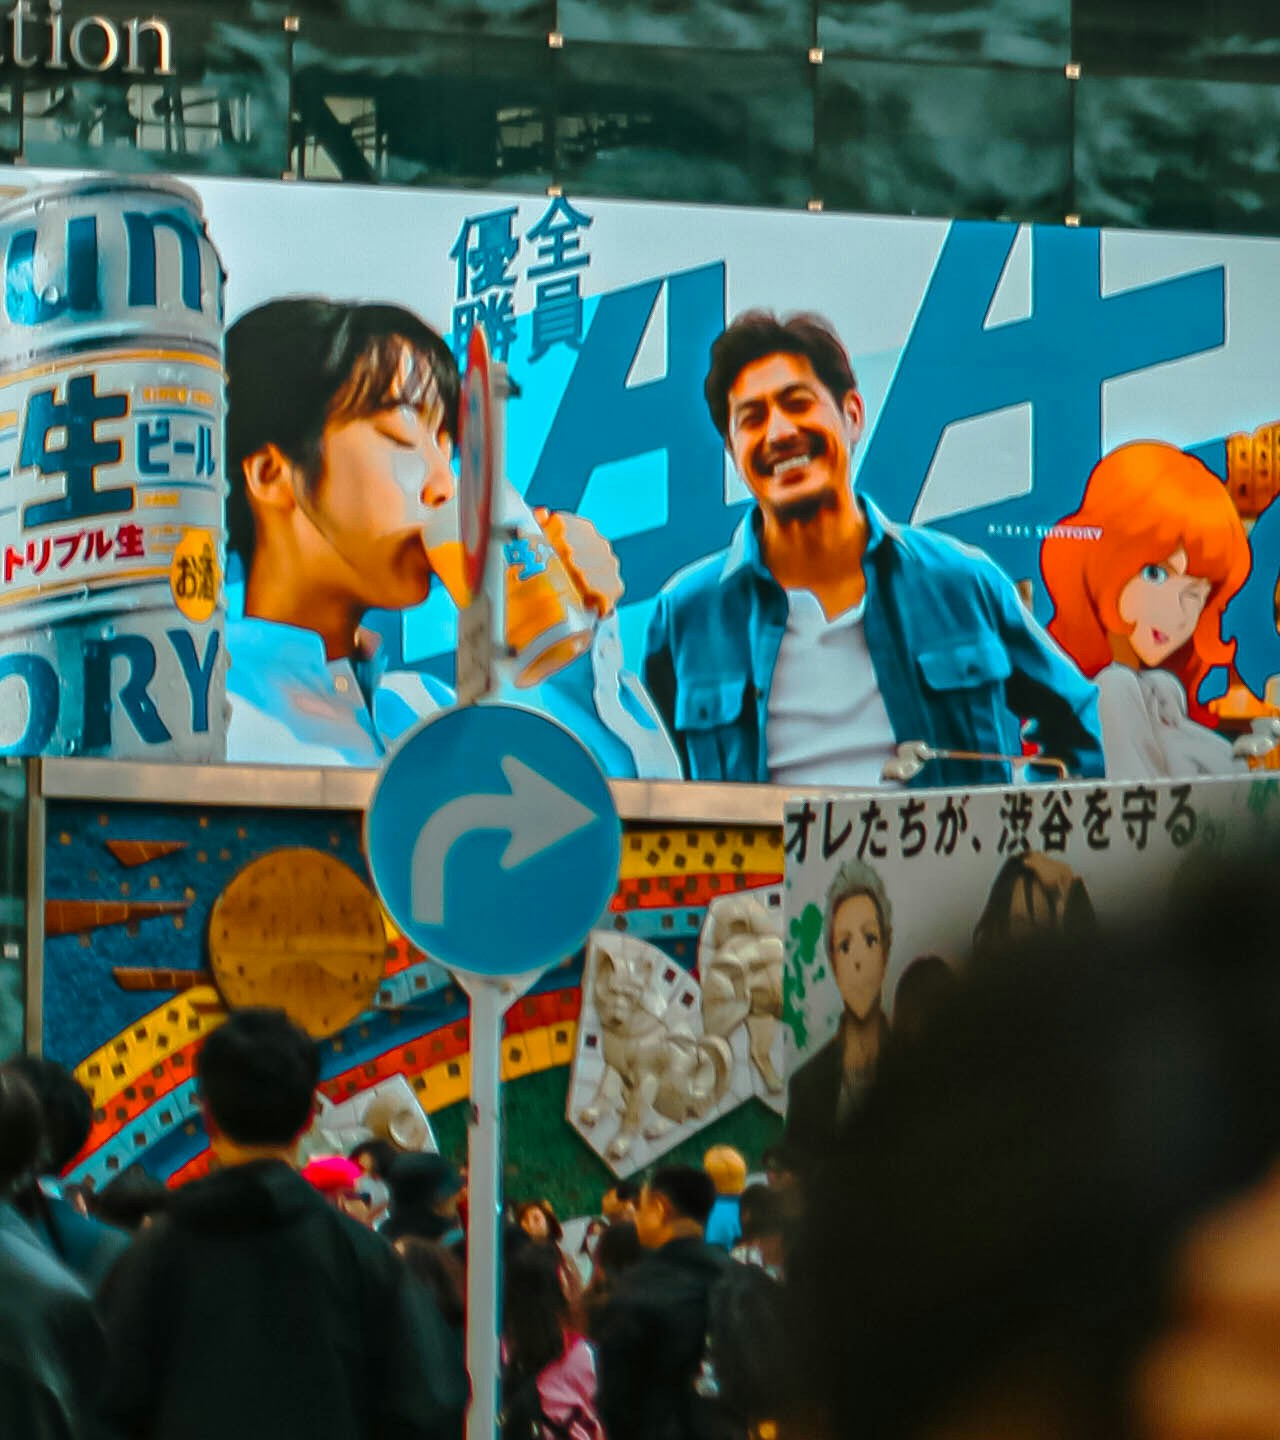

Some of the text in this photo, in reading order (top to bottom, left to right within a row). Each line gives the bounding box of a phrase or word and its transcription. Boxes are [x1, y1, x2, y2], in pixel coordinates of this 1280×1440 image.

[525, 196, 593, 365] 全員
[20, 373, 136, 529] 生
[136, 416, 216, 477] ビール
